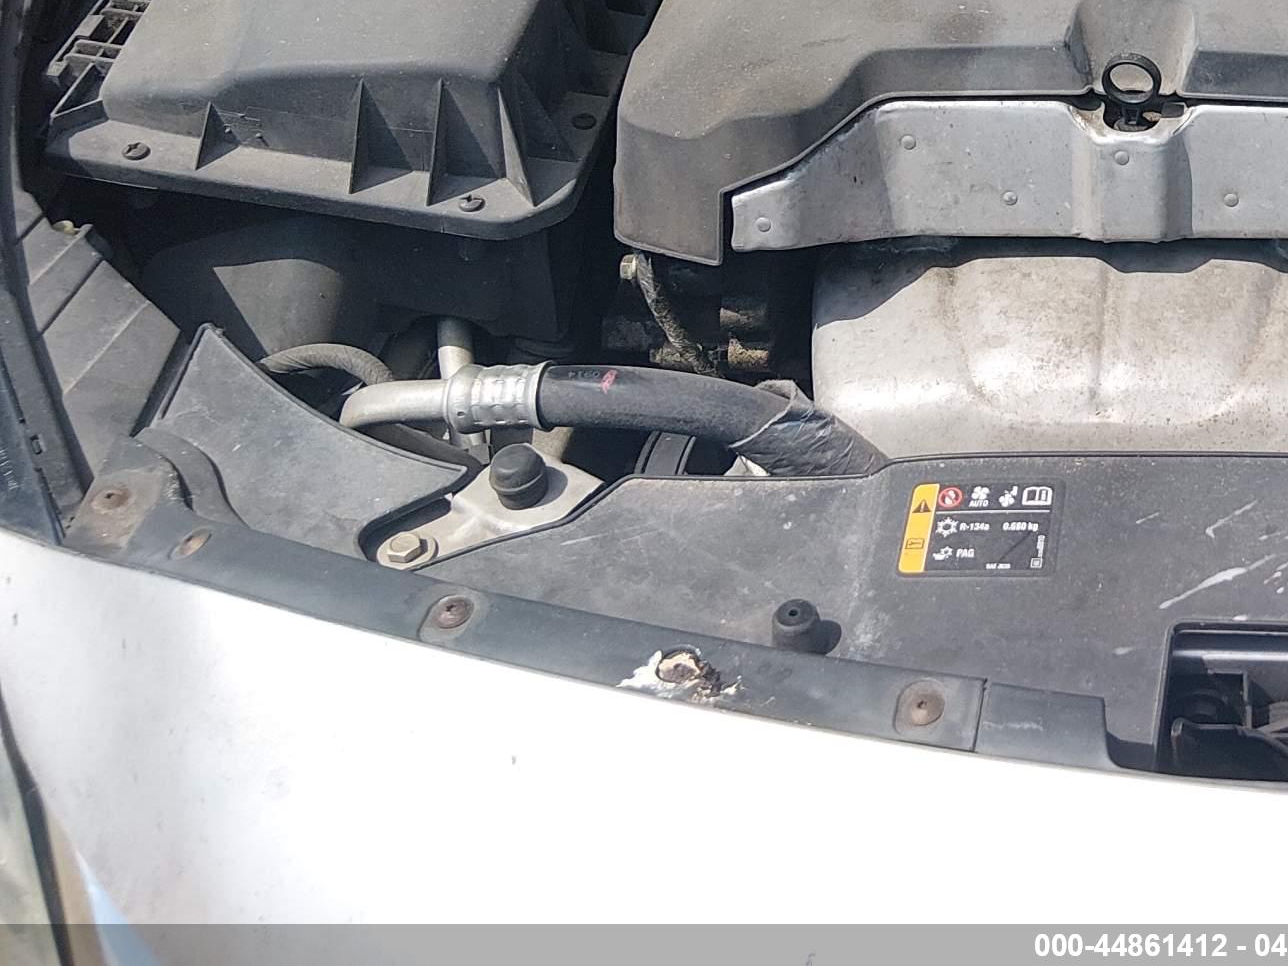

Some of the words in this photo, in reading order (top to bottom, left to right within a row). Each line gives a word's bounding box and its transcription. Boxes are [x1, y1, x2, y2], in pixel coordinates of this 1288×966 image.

[968, 499, 989, 507] AUTO
[959, 522, 990, 531] R-134a
[1027, 522, 1039, 532] kg
[956, 548, 975, 558] PAG
